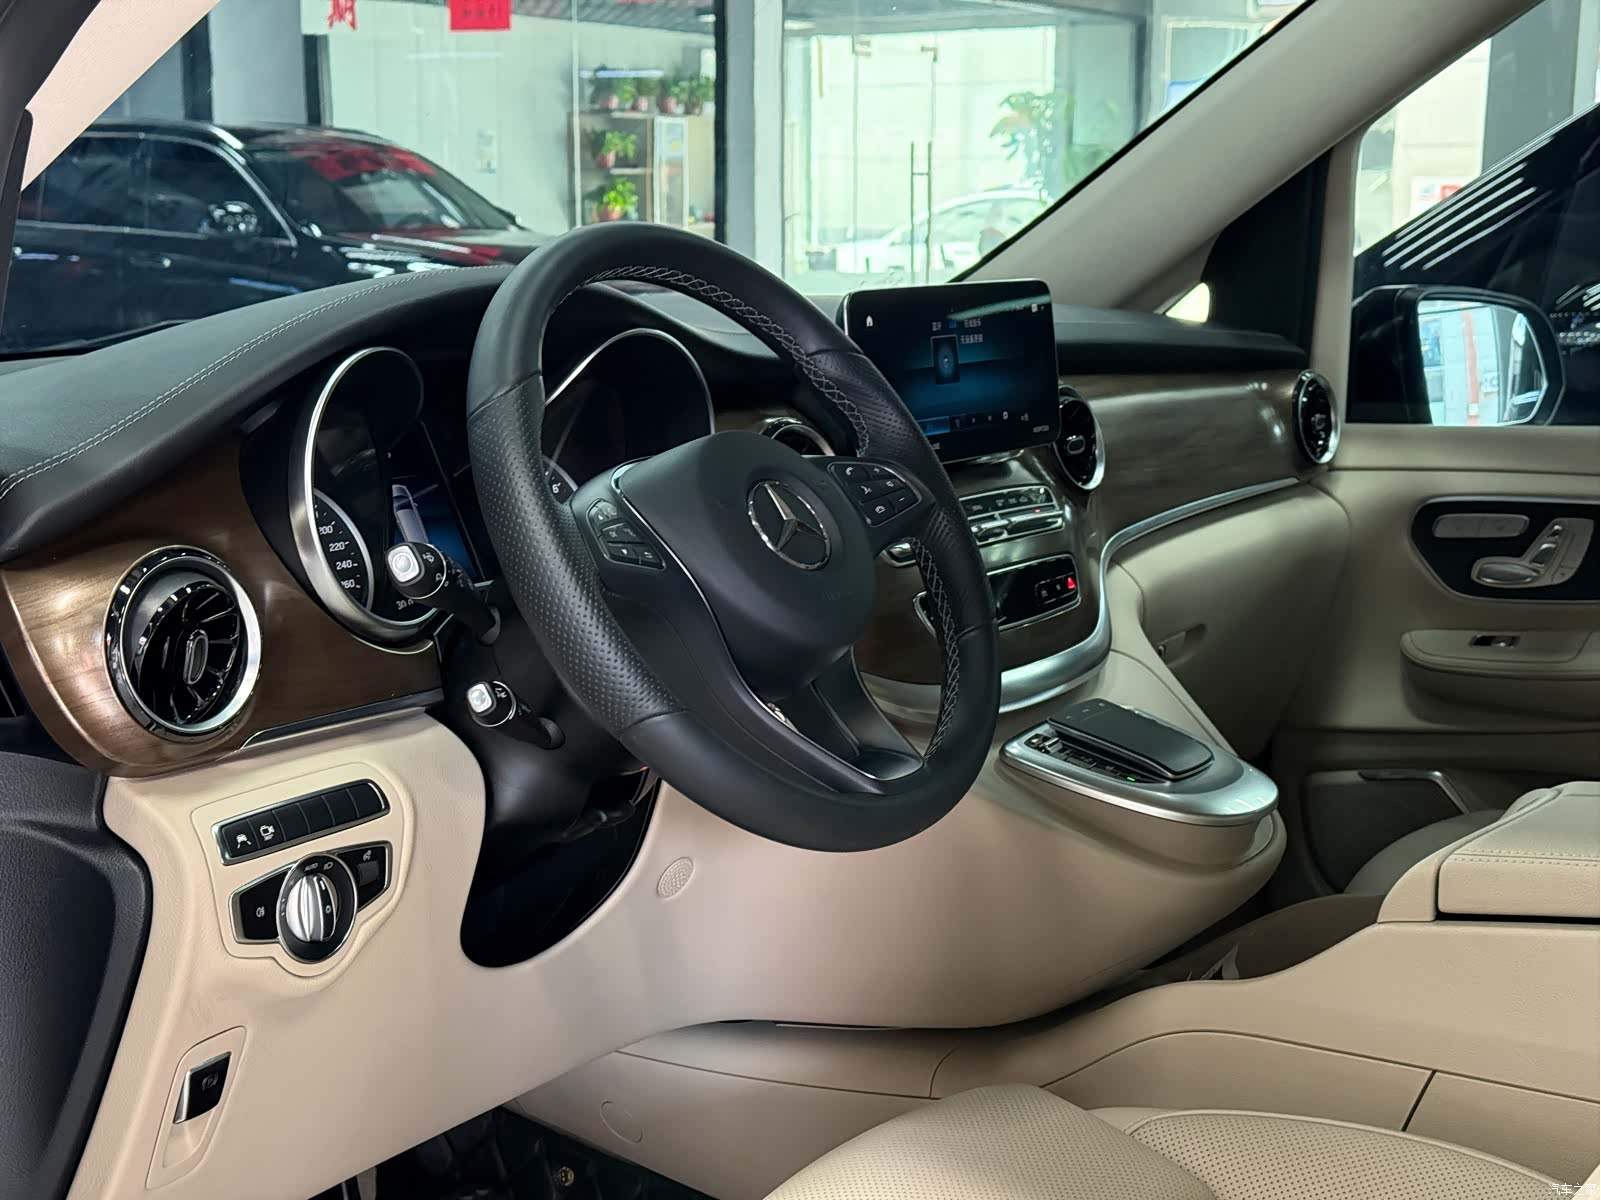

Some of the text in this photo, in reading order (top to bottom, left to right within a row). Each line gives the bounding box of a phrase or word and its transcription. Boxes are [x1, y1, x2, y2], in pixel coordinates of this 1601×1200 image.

[329, 542, 345, 552] 220
[336, 560, 352, 570] 240
[305, 863, 318, 871] AUTO
